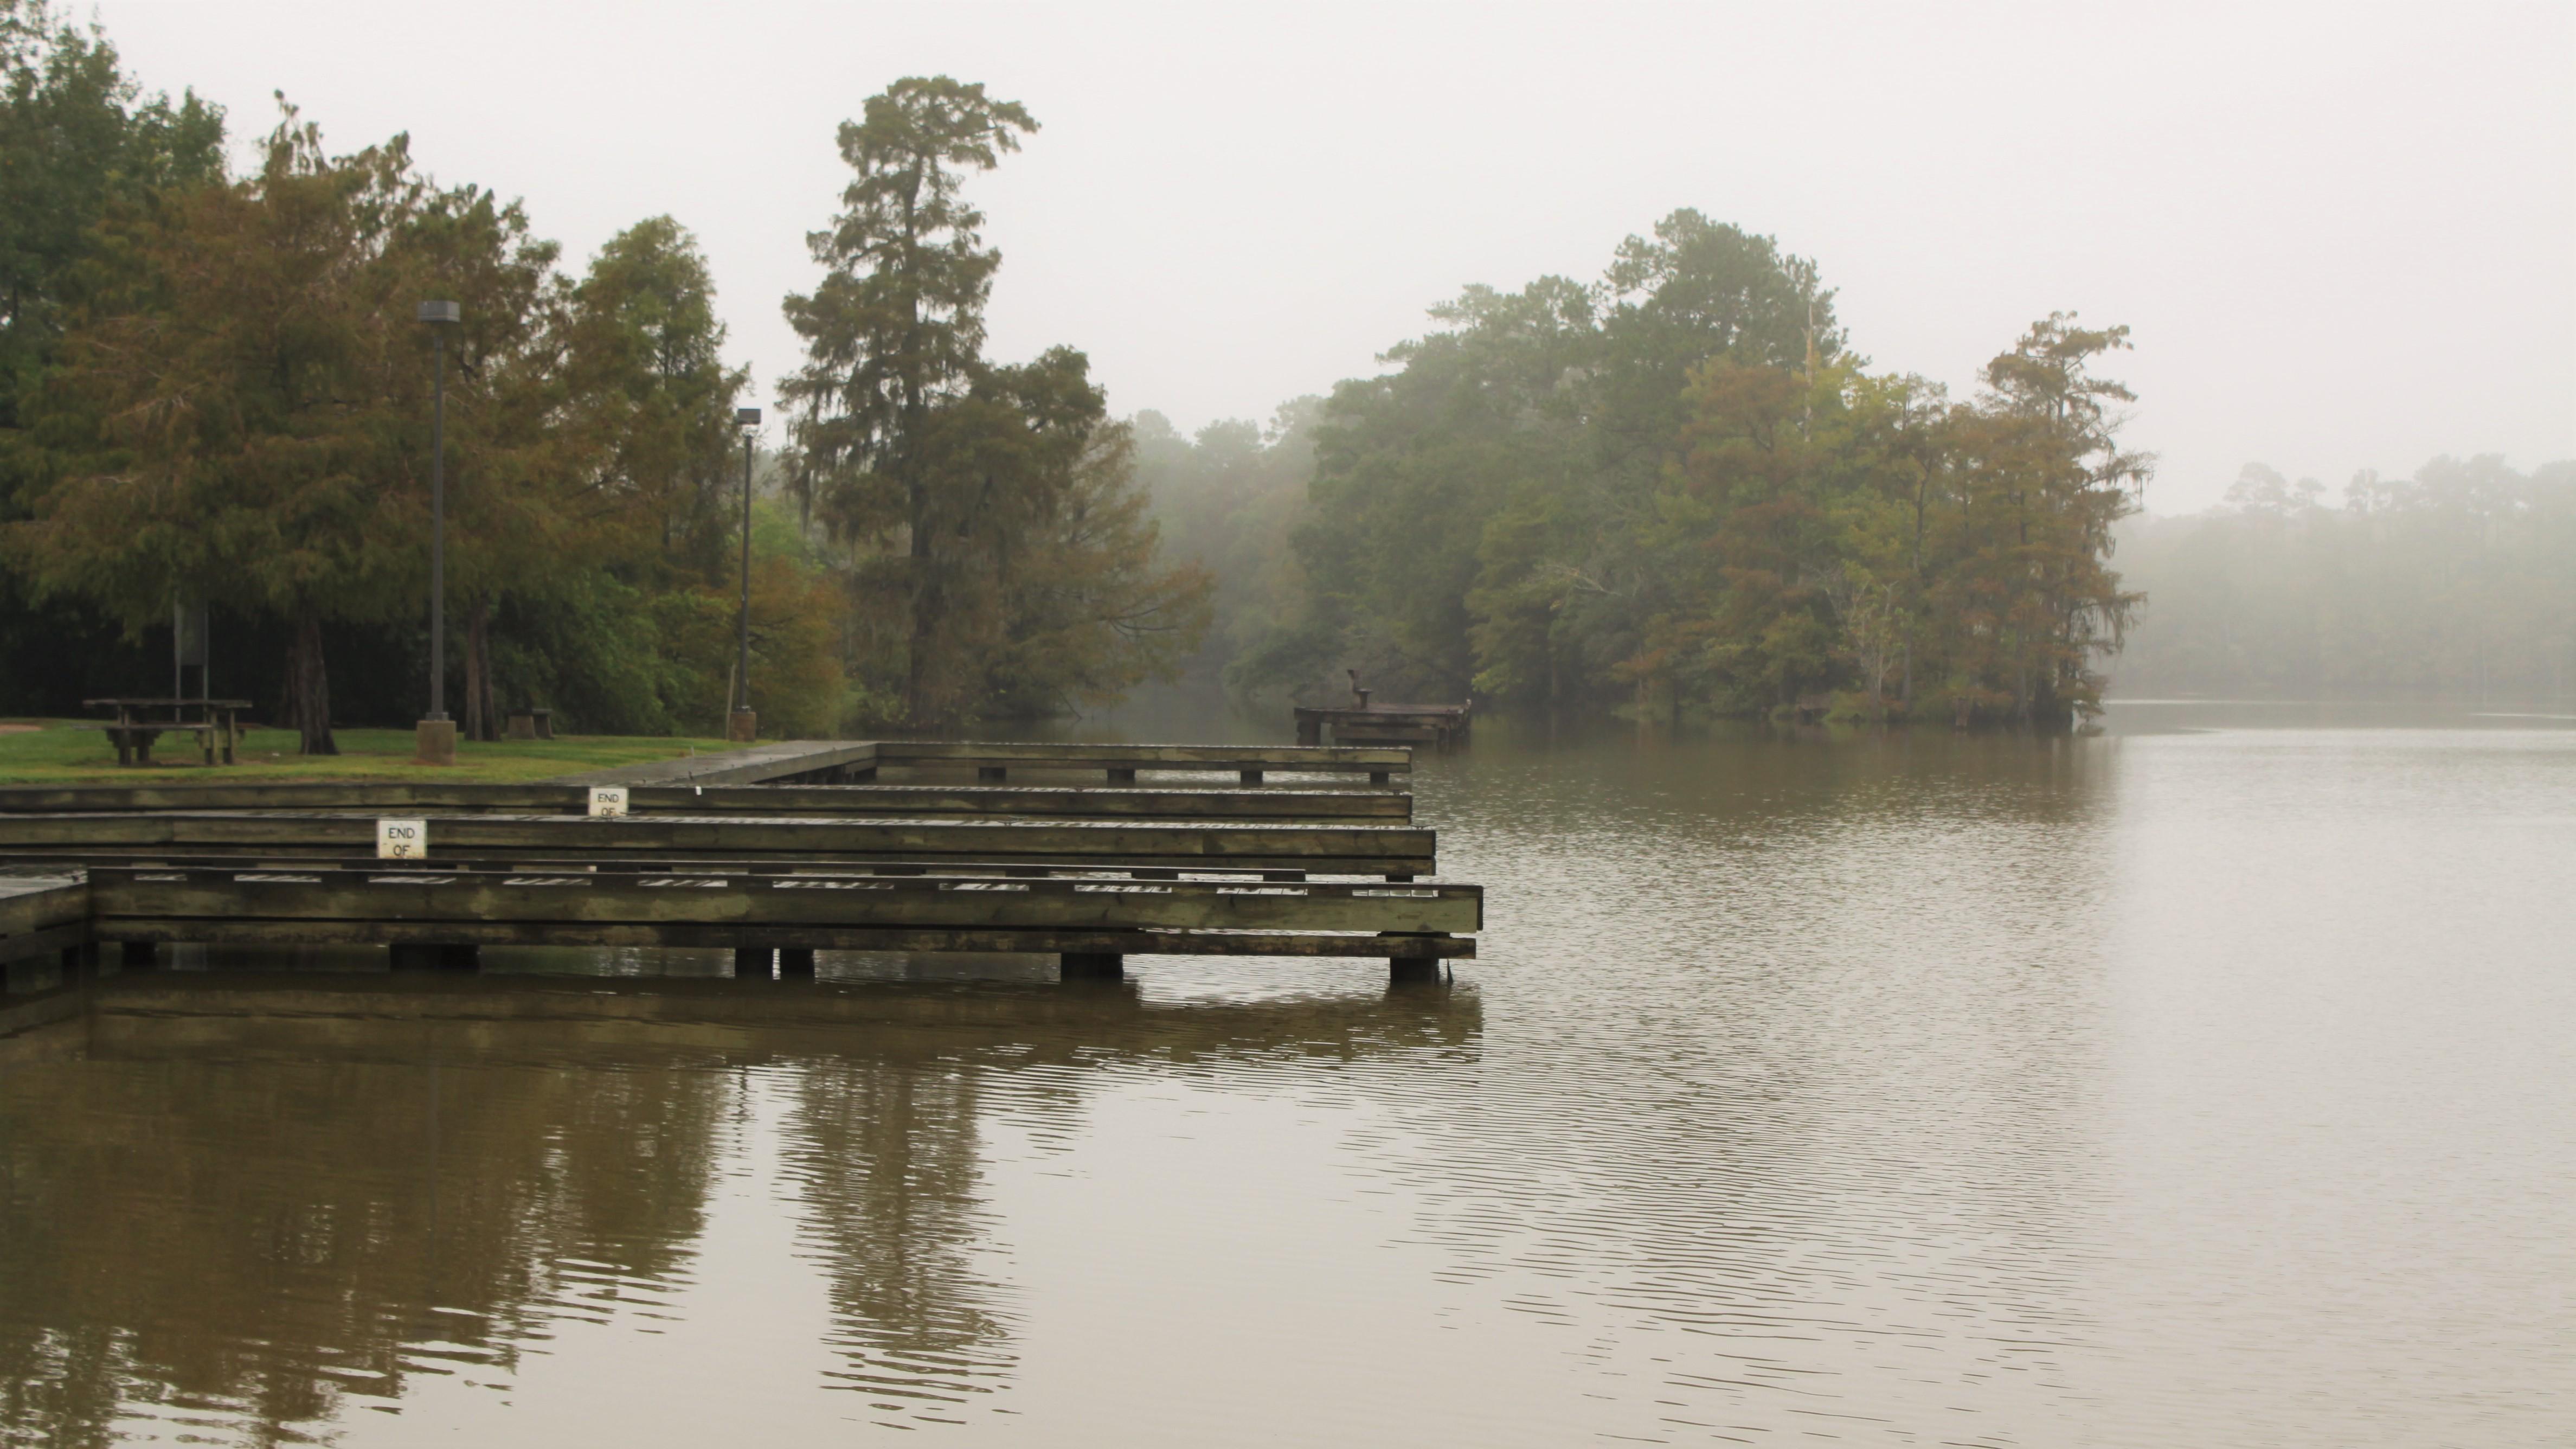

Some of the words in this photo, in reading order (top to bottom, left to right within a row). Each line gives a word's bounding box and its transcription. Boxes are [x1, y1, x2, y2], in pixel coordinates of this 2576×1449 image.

[598, 793, 619, 803] END
[601, 807, 615, 816] OF
[389, 828, 415, 839] END
[393, 845, 410, 856] OF
